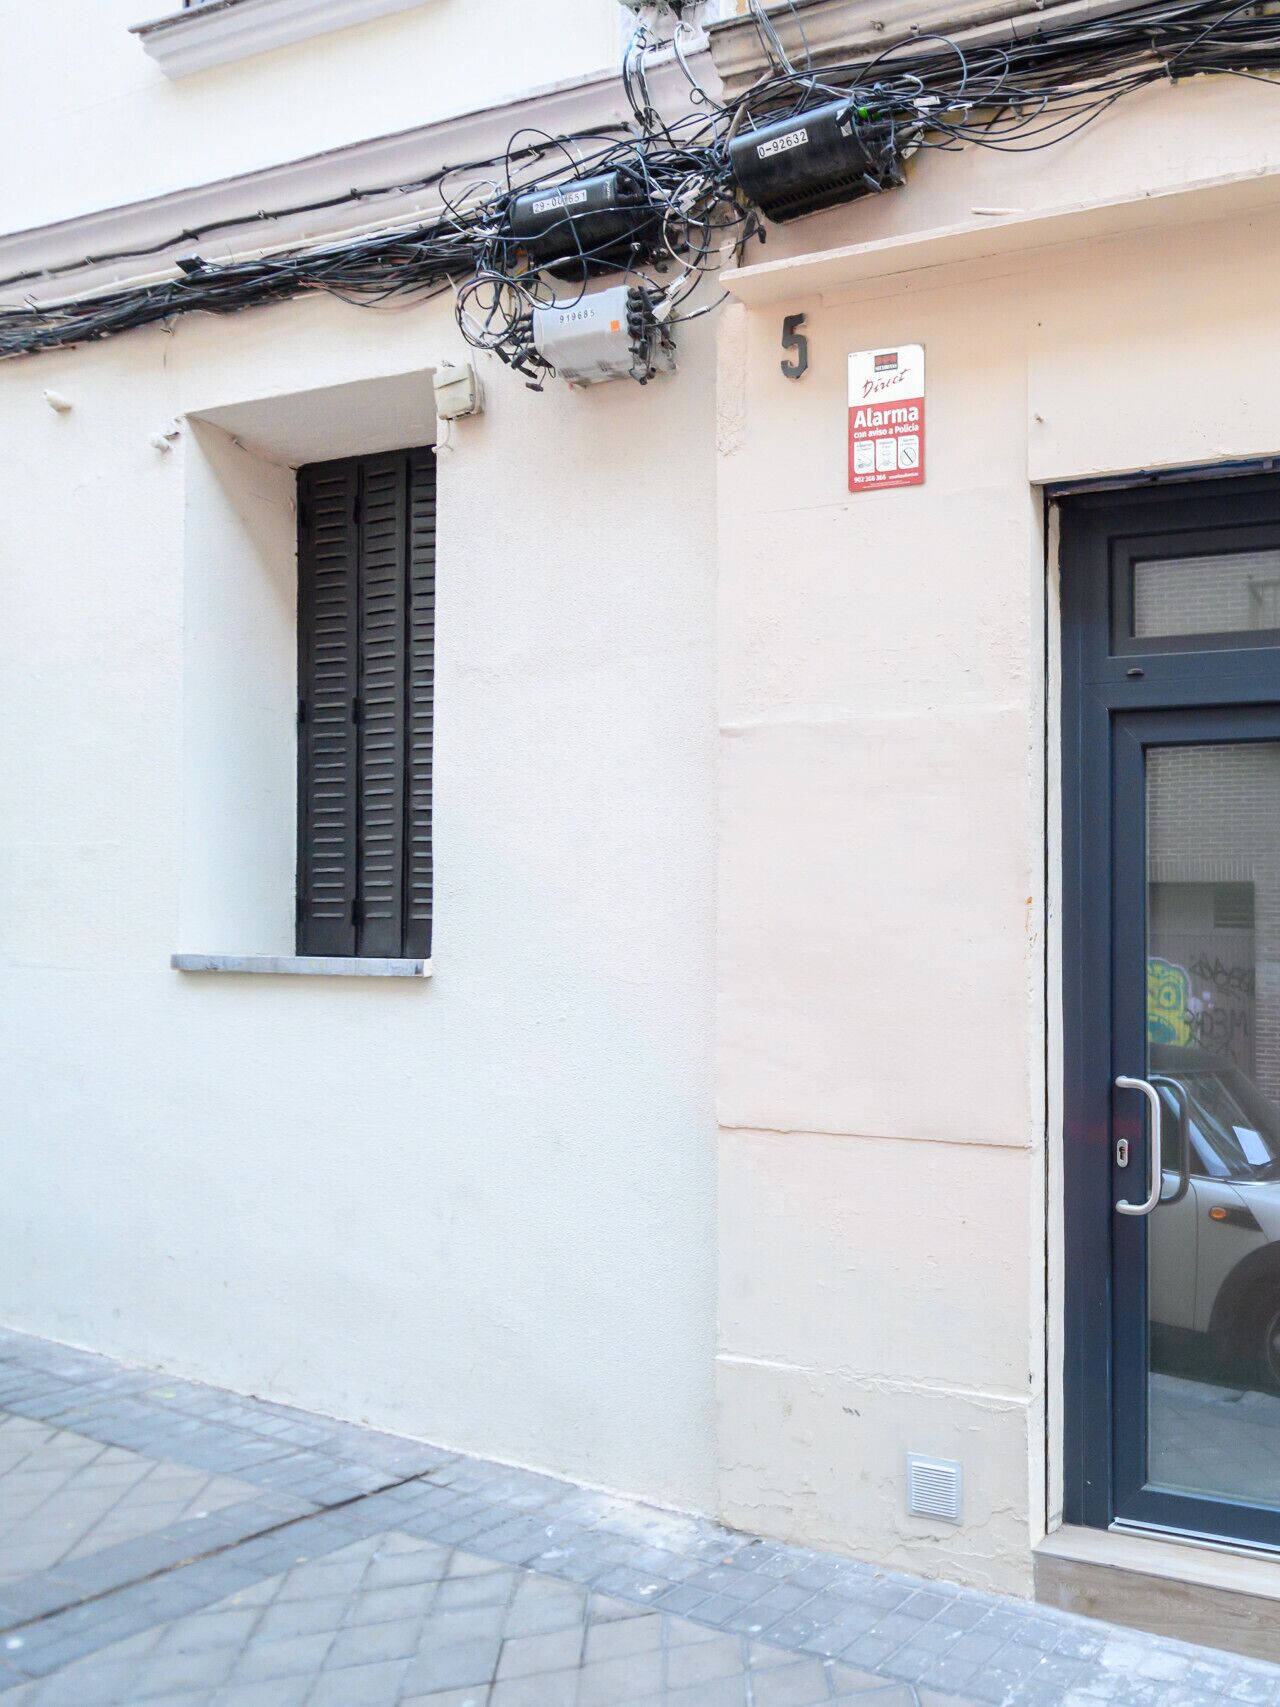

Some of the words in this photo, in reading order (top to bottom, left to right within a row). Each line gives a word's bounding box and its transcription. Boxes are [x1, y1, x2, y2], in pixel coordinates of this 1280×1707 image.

[758, 131, 807, 157] 0-92632
[559, 310, 595, 323] 919685
[781, 313, 808, 379] 5
[862, 368, 911, 398] Direct
[854, 406, 919, 429] Alarma
[867, 427, 887, 438] aviso
[894, 423, 919, 433] Policía
